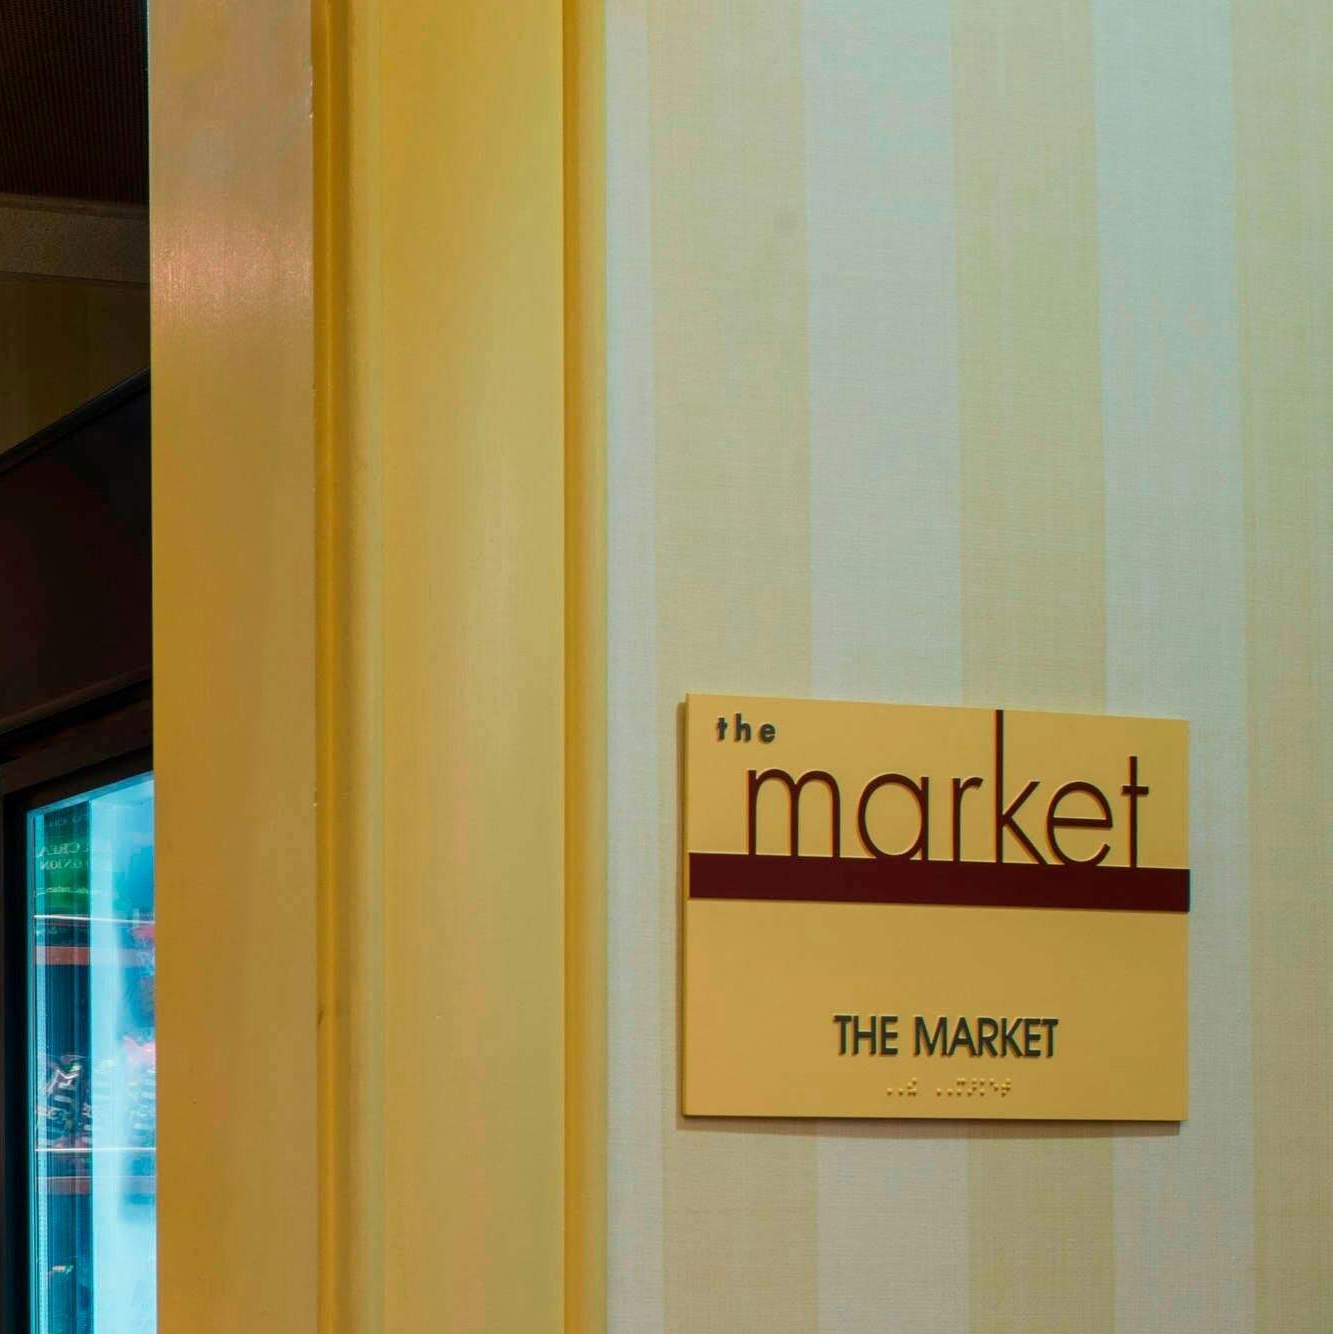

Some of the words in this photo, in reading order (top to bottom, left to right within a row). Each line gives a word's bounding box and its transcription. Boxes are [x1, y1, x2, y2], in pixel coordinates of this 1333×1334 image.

[714, 713, 777, 743] the
[746, 709, 1150, 868] market
[833, 1014, 899, 1056] THE
[913, 1016, 1059, 1058] MARKET
